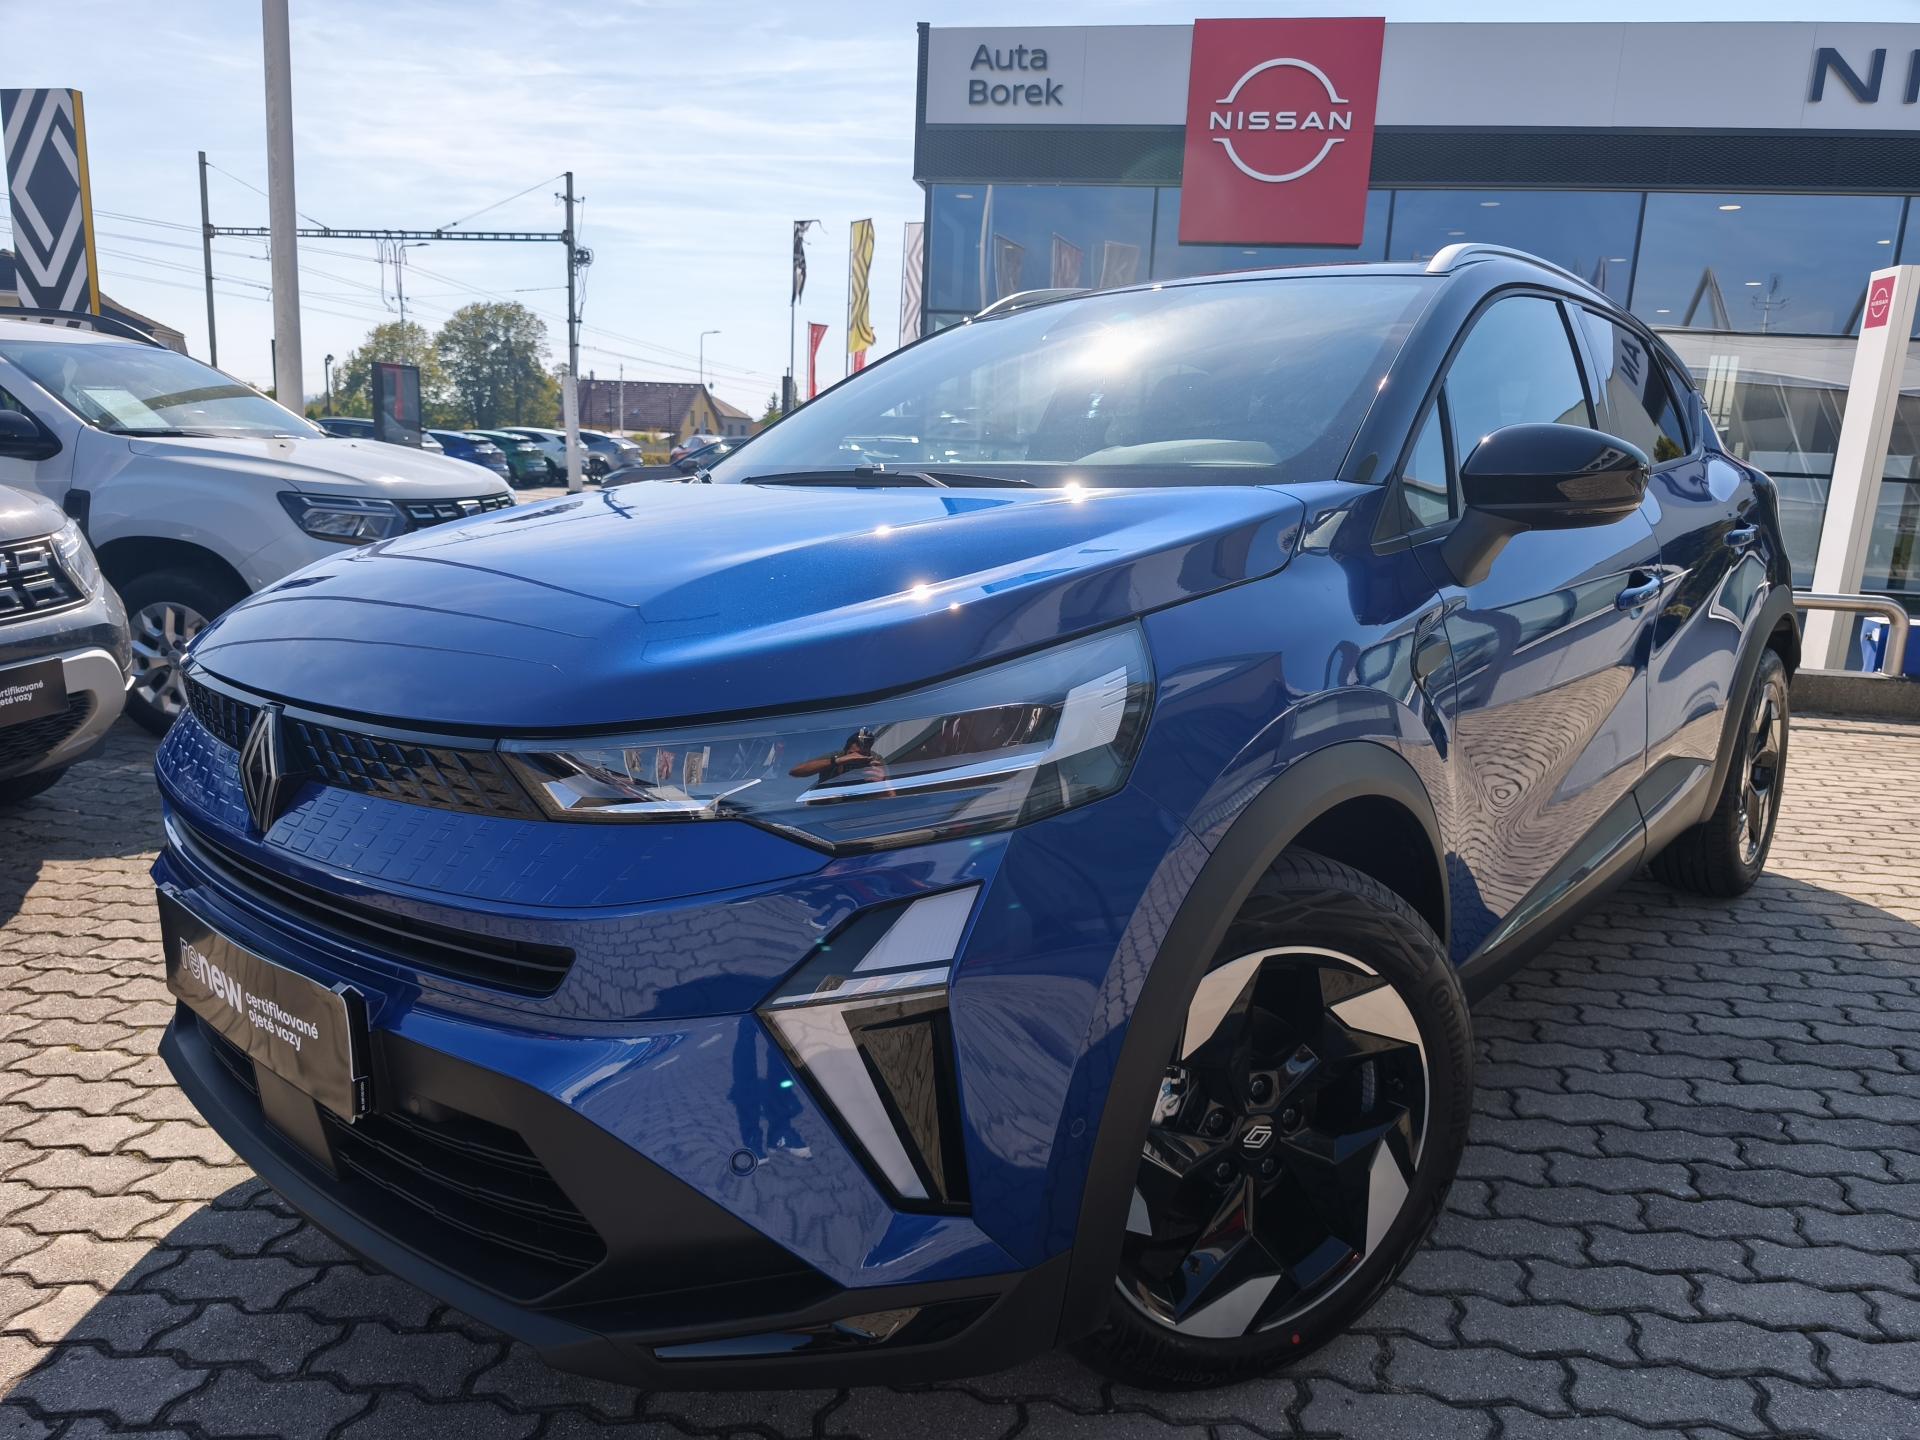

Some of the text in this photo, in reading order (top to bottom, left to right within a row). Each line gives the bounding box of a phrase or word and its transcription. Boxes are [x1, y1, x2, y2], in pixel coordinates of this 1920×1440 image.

[970, 43, 1048, 71] Auta
[968, 77, 1063, 106] Borek
[1209, 111, 1352, 130] NISSAN
[0, 679, 44, 698] rtifikované
[179, 936, 243, 1014] renew
[245, 992, 319, 1040] certifikované
[248, 1009, 302, 1052] ojeté vozy
